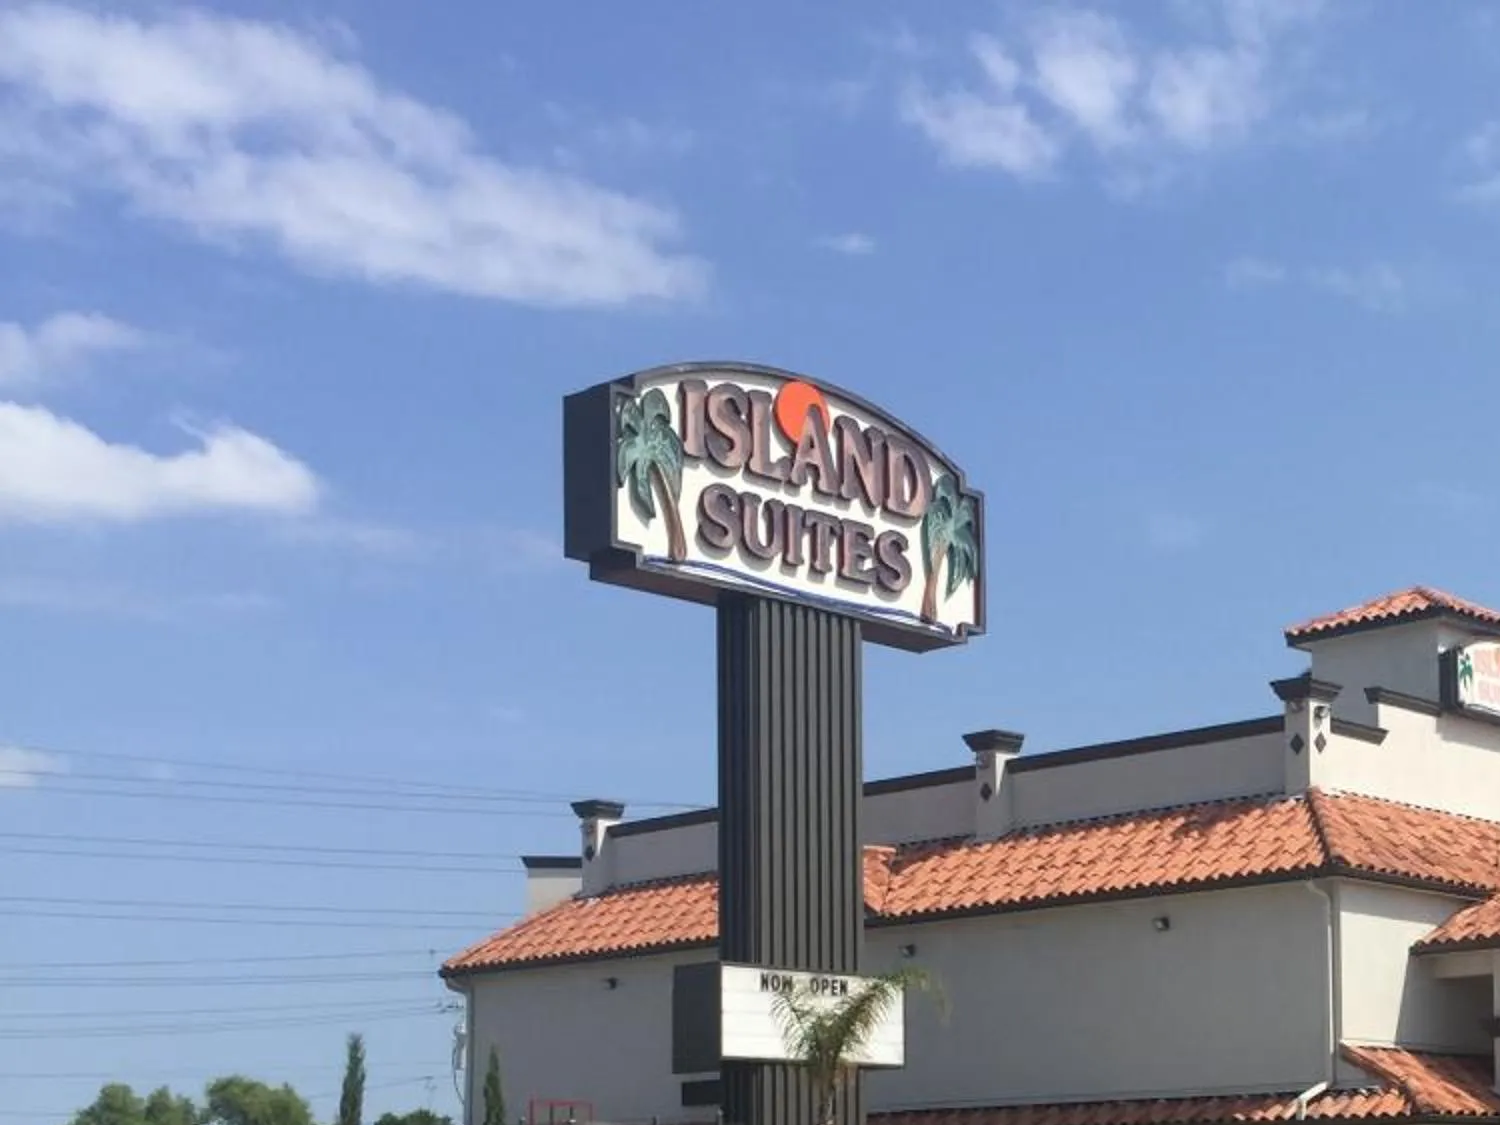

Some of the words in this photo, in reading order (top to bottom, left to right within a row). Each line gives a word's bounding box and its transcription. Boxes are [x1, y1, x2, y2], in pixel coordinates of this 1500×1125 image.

[677, 378, 933, 520] ISLAND
[698, 482, 913, 594] SUITES
[761, 972, 793, 993] NOW
[809, 976, 849, 997] OPEN
